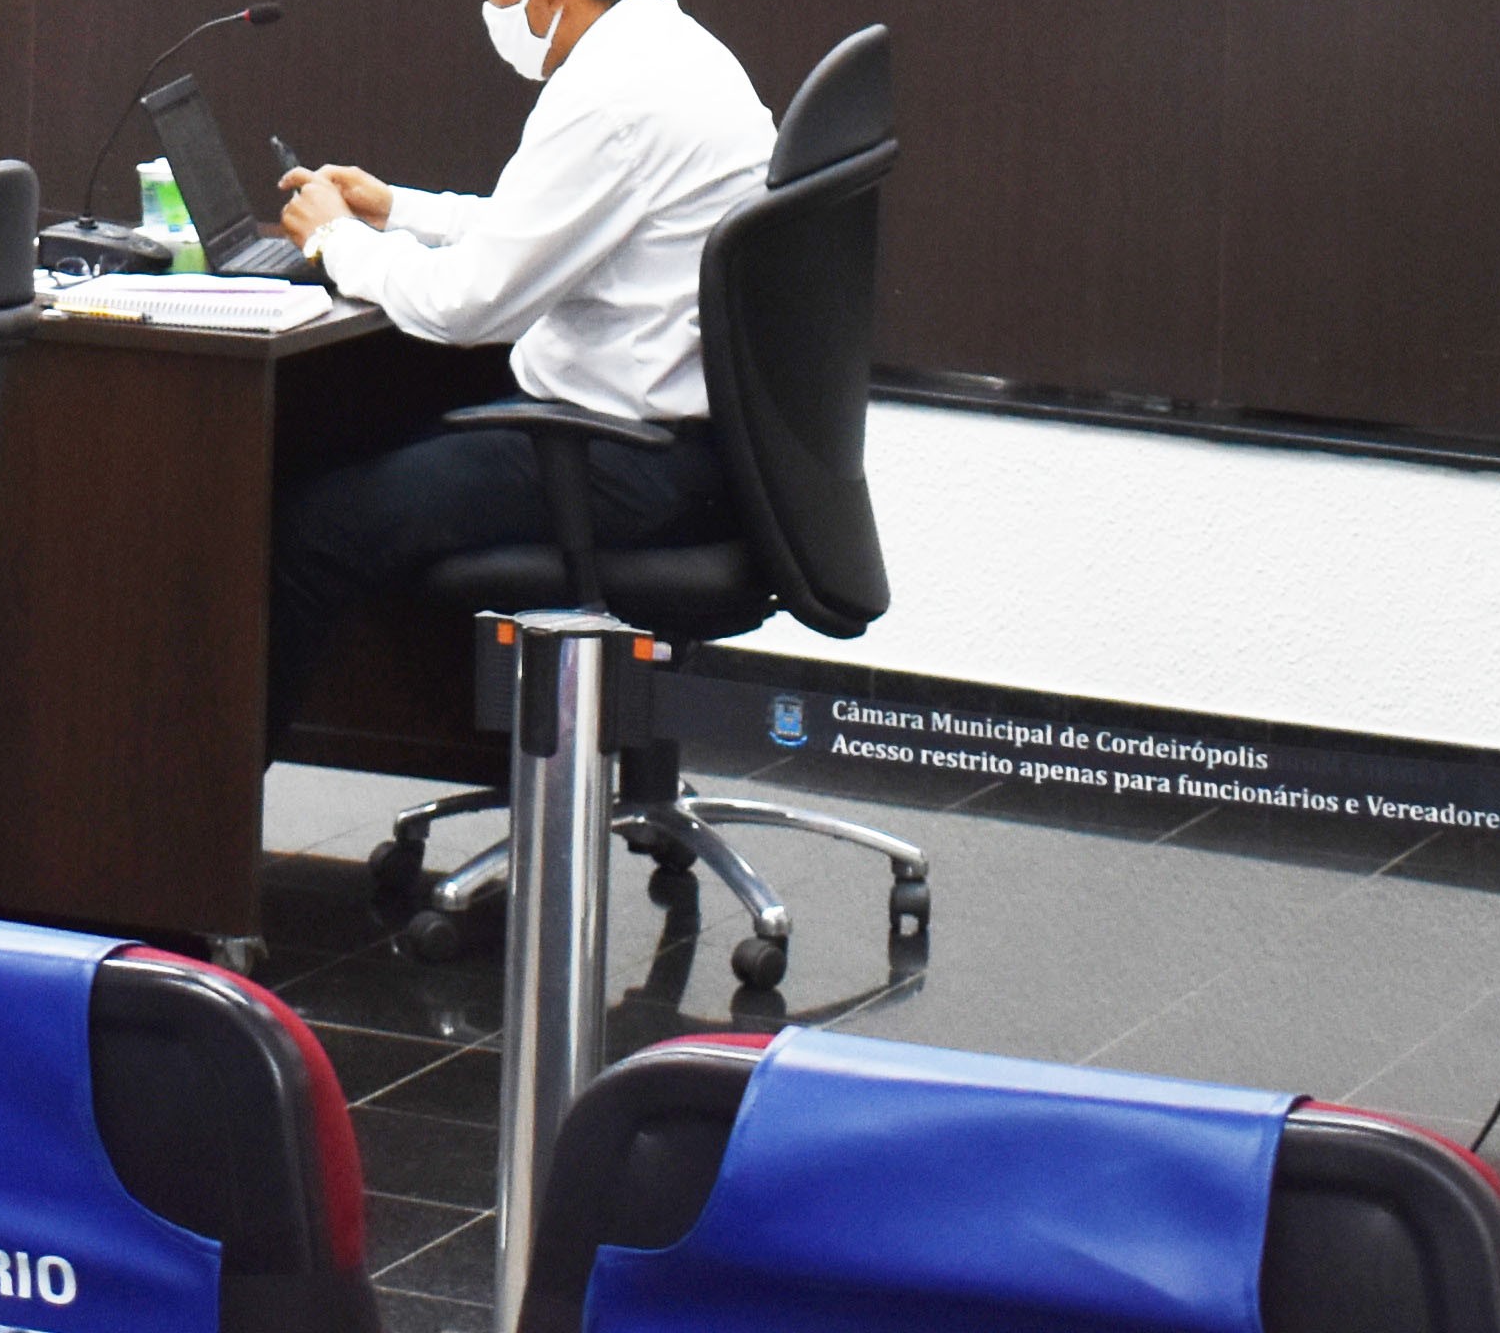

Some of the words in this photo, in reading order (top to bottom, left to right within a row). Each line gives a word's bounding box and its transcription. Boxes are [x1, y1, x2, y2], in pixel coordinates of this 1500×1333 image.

[832, 699, 924, 731] Câmara
[931, 711, 1053, 748] Municipal
[1060, 726, 1089, 749] de
[1096, 731, 1268, 770] Cordeirópolis
[832, 734, 914, 763] Acesso
[920, 747, 1013, 775] restrito
[1019, 761, 1107, 787] apenas
[1114, 771, 1171, 794] para
[1178, 773, 1339, 813] funcionários
[1345, 798, 1359, 815] e
